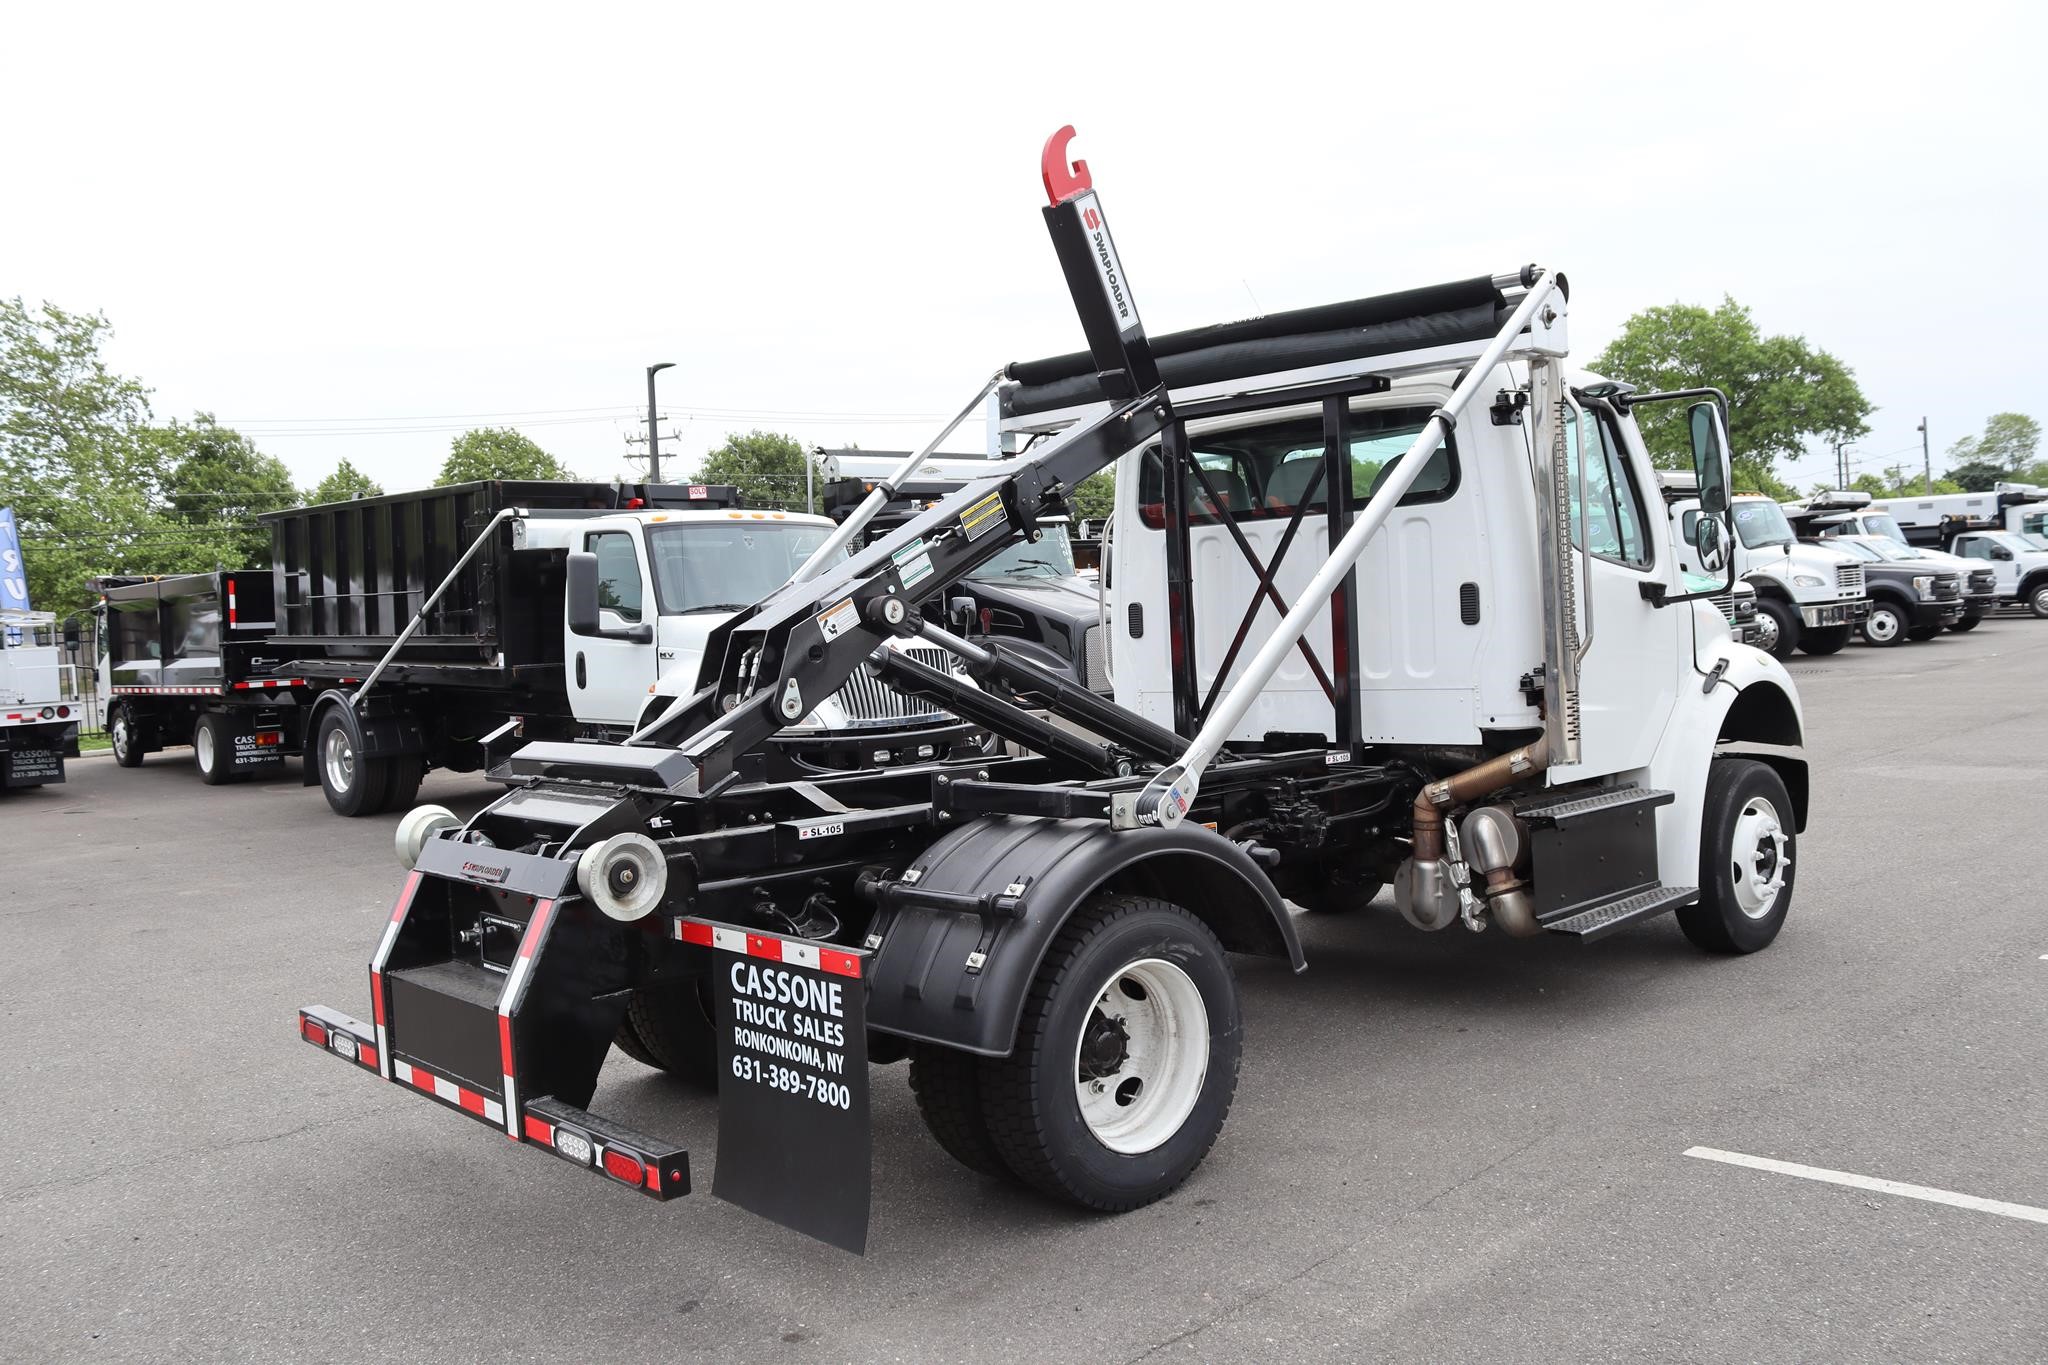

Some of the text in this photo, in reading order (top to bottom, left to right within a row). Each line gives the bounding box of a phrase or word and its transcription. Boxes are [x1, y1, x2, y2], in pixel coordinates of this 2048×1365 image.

[1094, 231, 1129, 319] SWAPLOADER
[690, 487, 706, 495] SOLD
[659, 652, 675, 660] MV
[11, 750, 51, 759] CASSON
[810, 825, 842, 837] SL-105
[730, 961, 844, 1018] CASSONE
[732, 998, 845, 1047] TRUCK SALES
[734, 1026, 845, 1075] RONKONKOMA, NY
[732, 1054, 851, 1110] 631-389-7800
